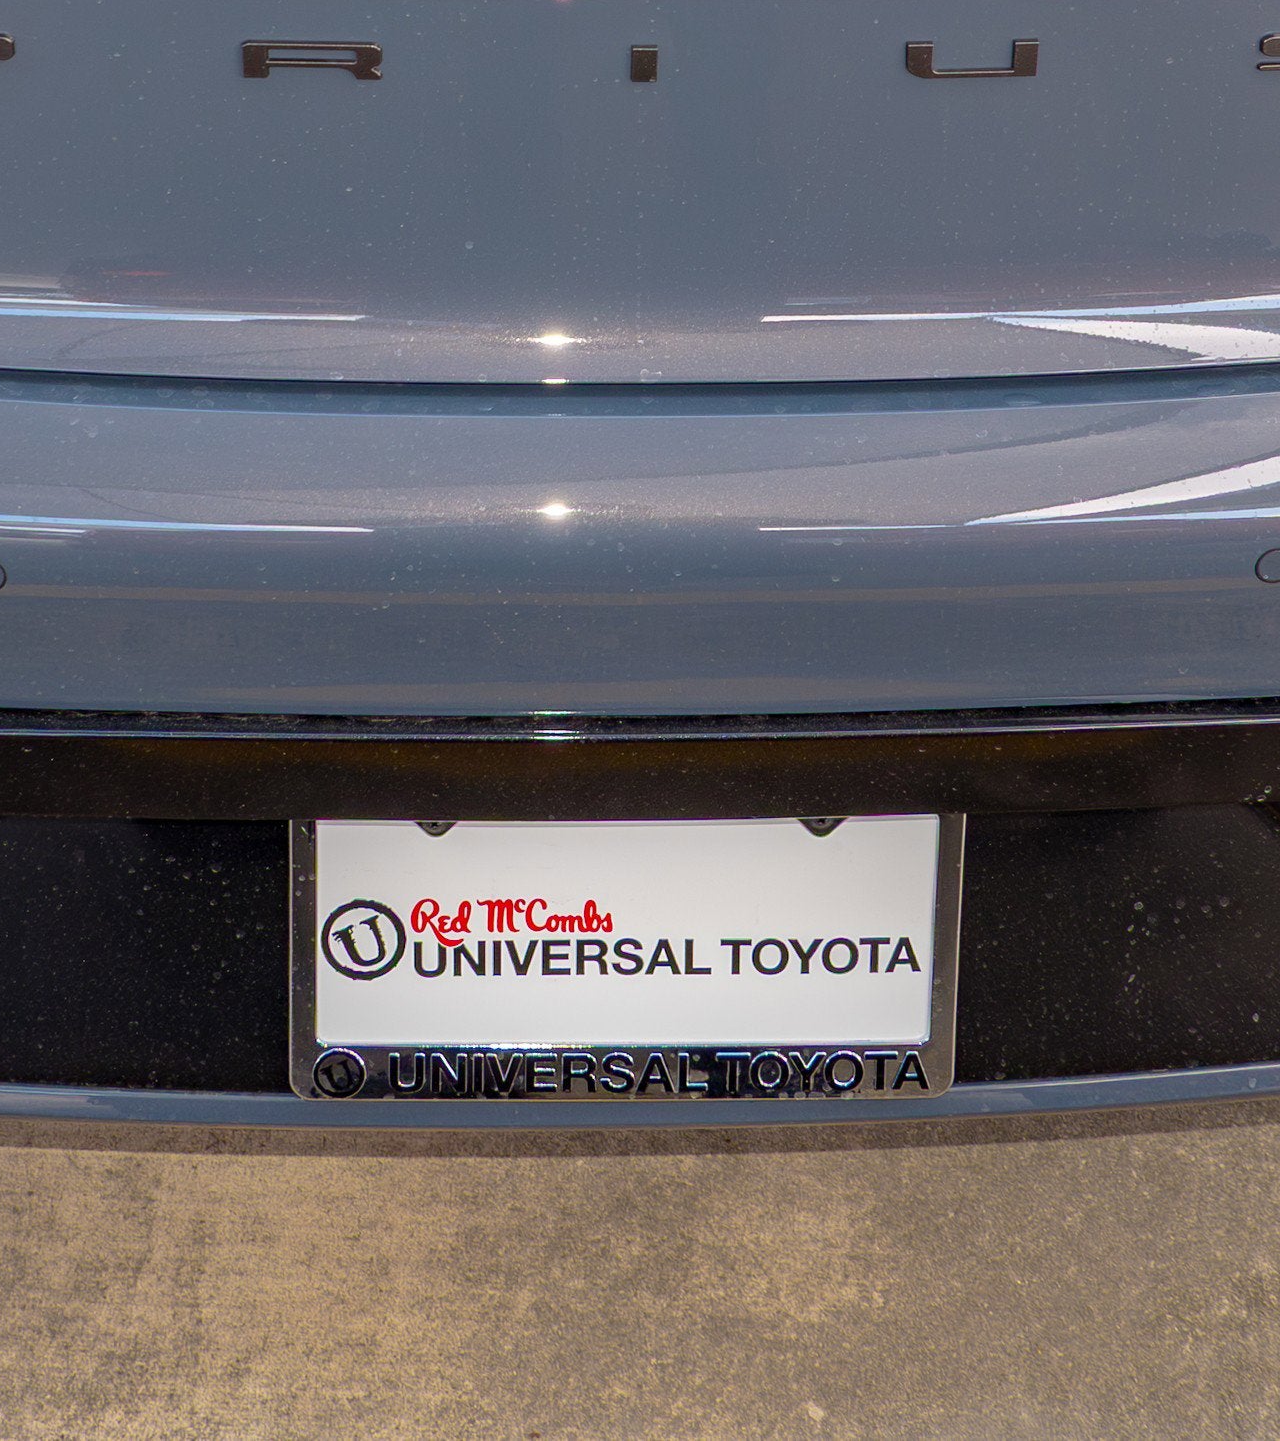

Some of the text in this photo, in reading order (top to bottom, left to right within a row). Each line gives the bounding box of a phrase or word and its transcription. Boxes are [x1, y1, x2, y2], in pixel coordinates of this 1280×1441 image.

[411, 898, 613, 947] Red McCombs
[414, 937, 922, 978] UNIVERSAL TOYOTA
[388, 1050, 931, 1095] UNIVERSAL TOYOTA
